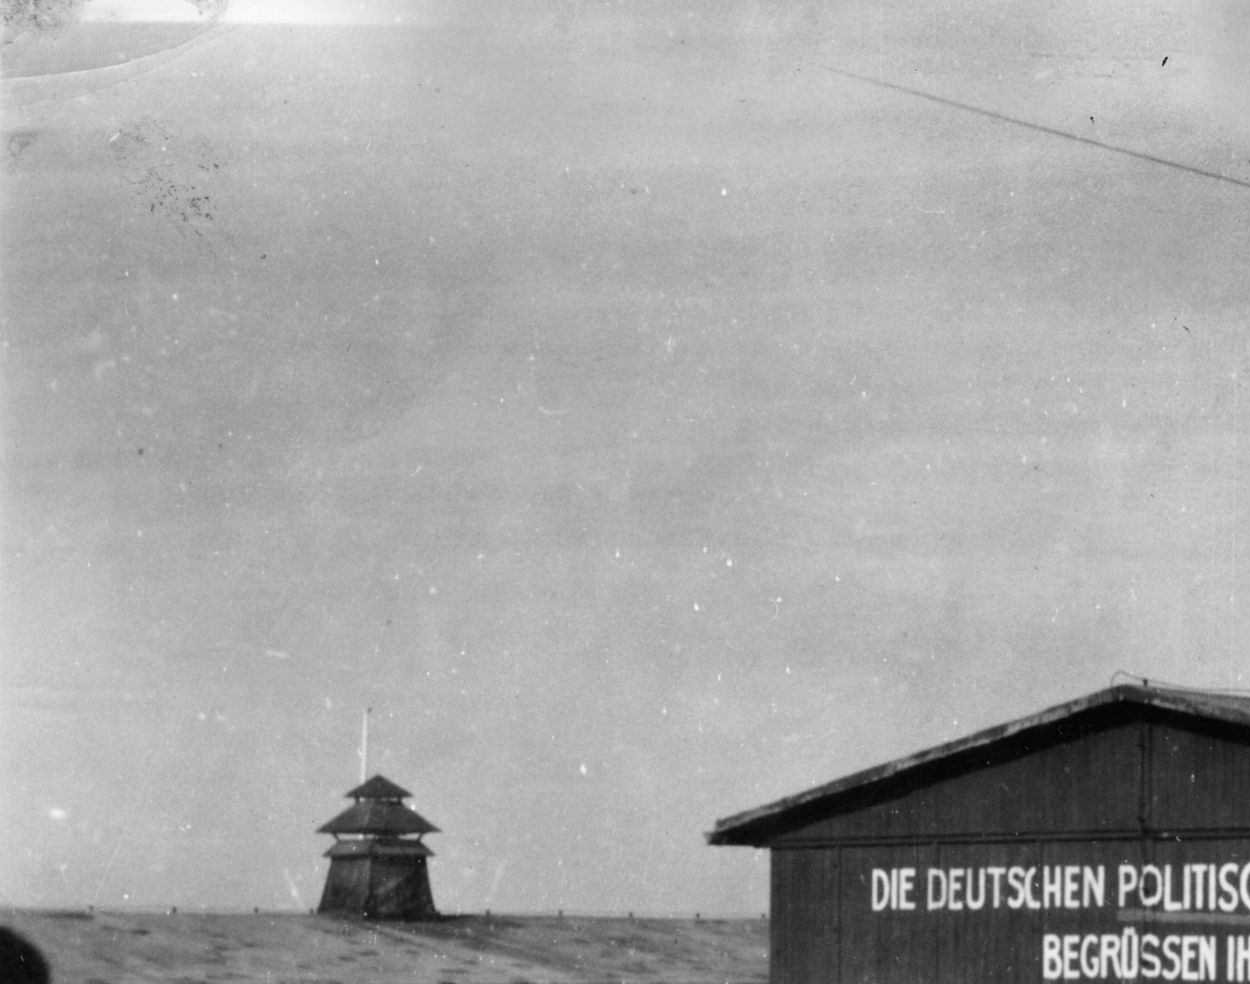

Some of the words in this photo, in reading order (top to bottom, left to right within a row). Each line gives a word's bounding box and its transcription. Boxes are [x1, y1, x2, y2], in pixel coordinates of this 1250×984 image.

[872, 867, 916, 911] DIE
[927, 865, 1105, 911] DEUTSCHEN
[1043, 926, 1217, 981] BEGRÜSSEN
